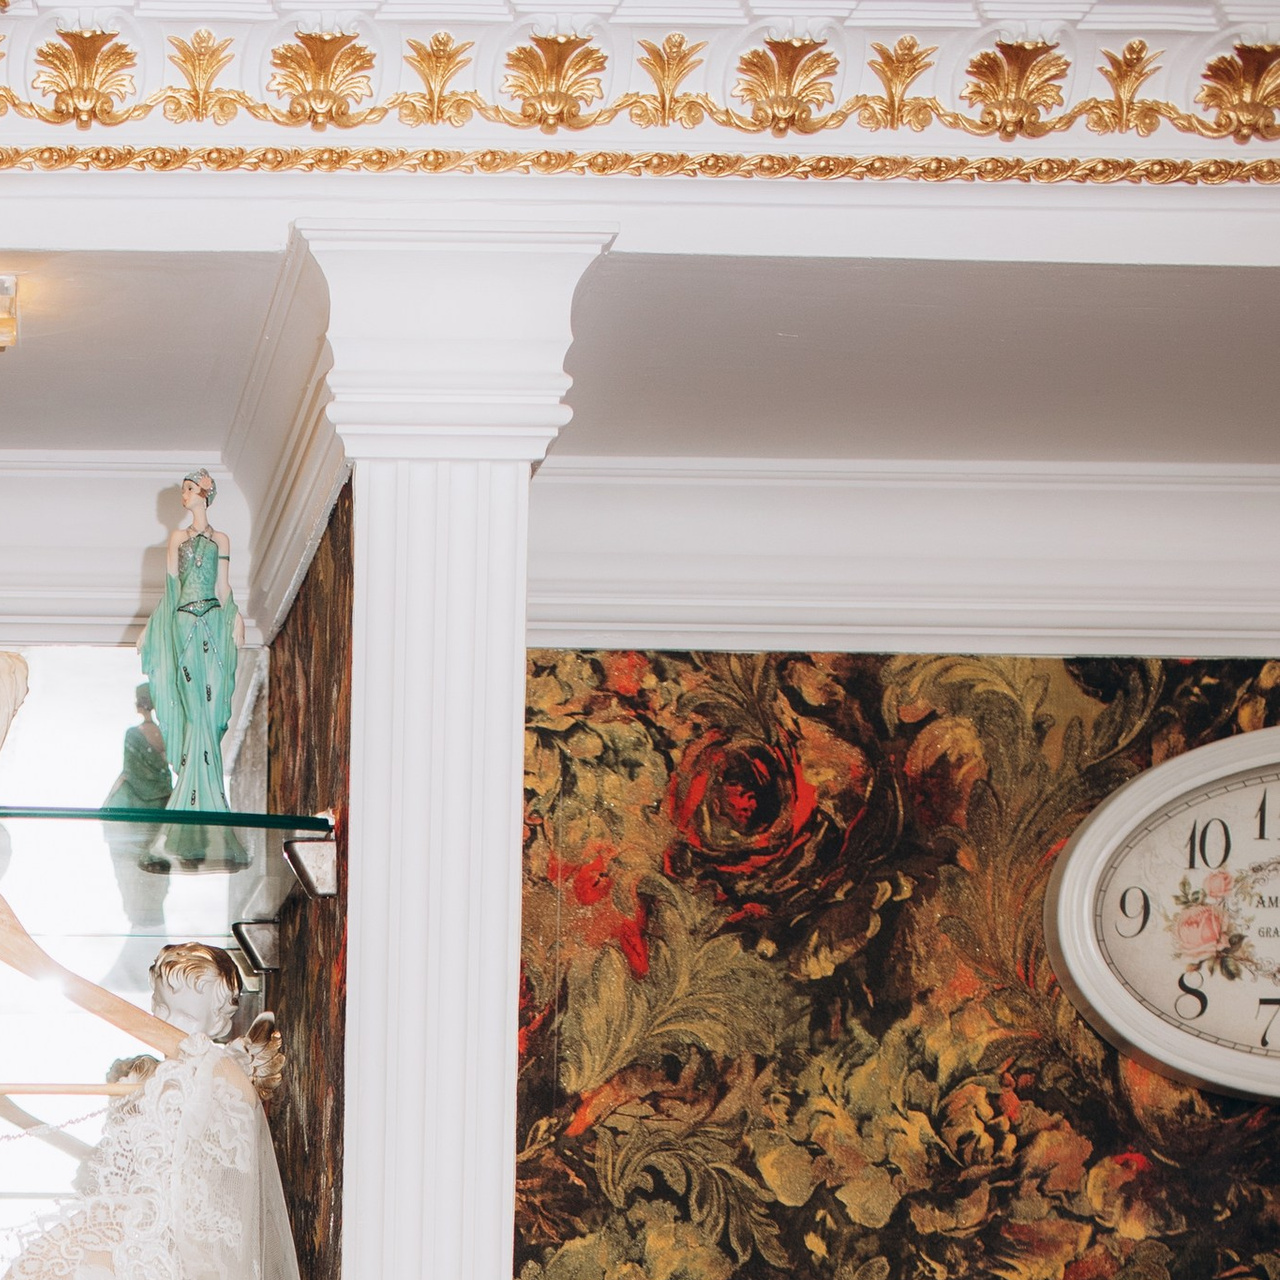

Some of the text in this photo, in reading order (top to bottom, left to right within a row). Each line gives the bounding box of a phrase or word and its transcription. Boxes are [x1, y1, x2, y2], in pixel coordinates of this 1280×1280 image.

[1254, 788, 1280, 841] 1
[1184, 818, 1231, 870] 10
[1115, 886, 1151, 938] 9
[1174, 972, 1209, 1019] 8
[1255, 997, 1280, 1047] 7
